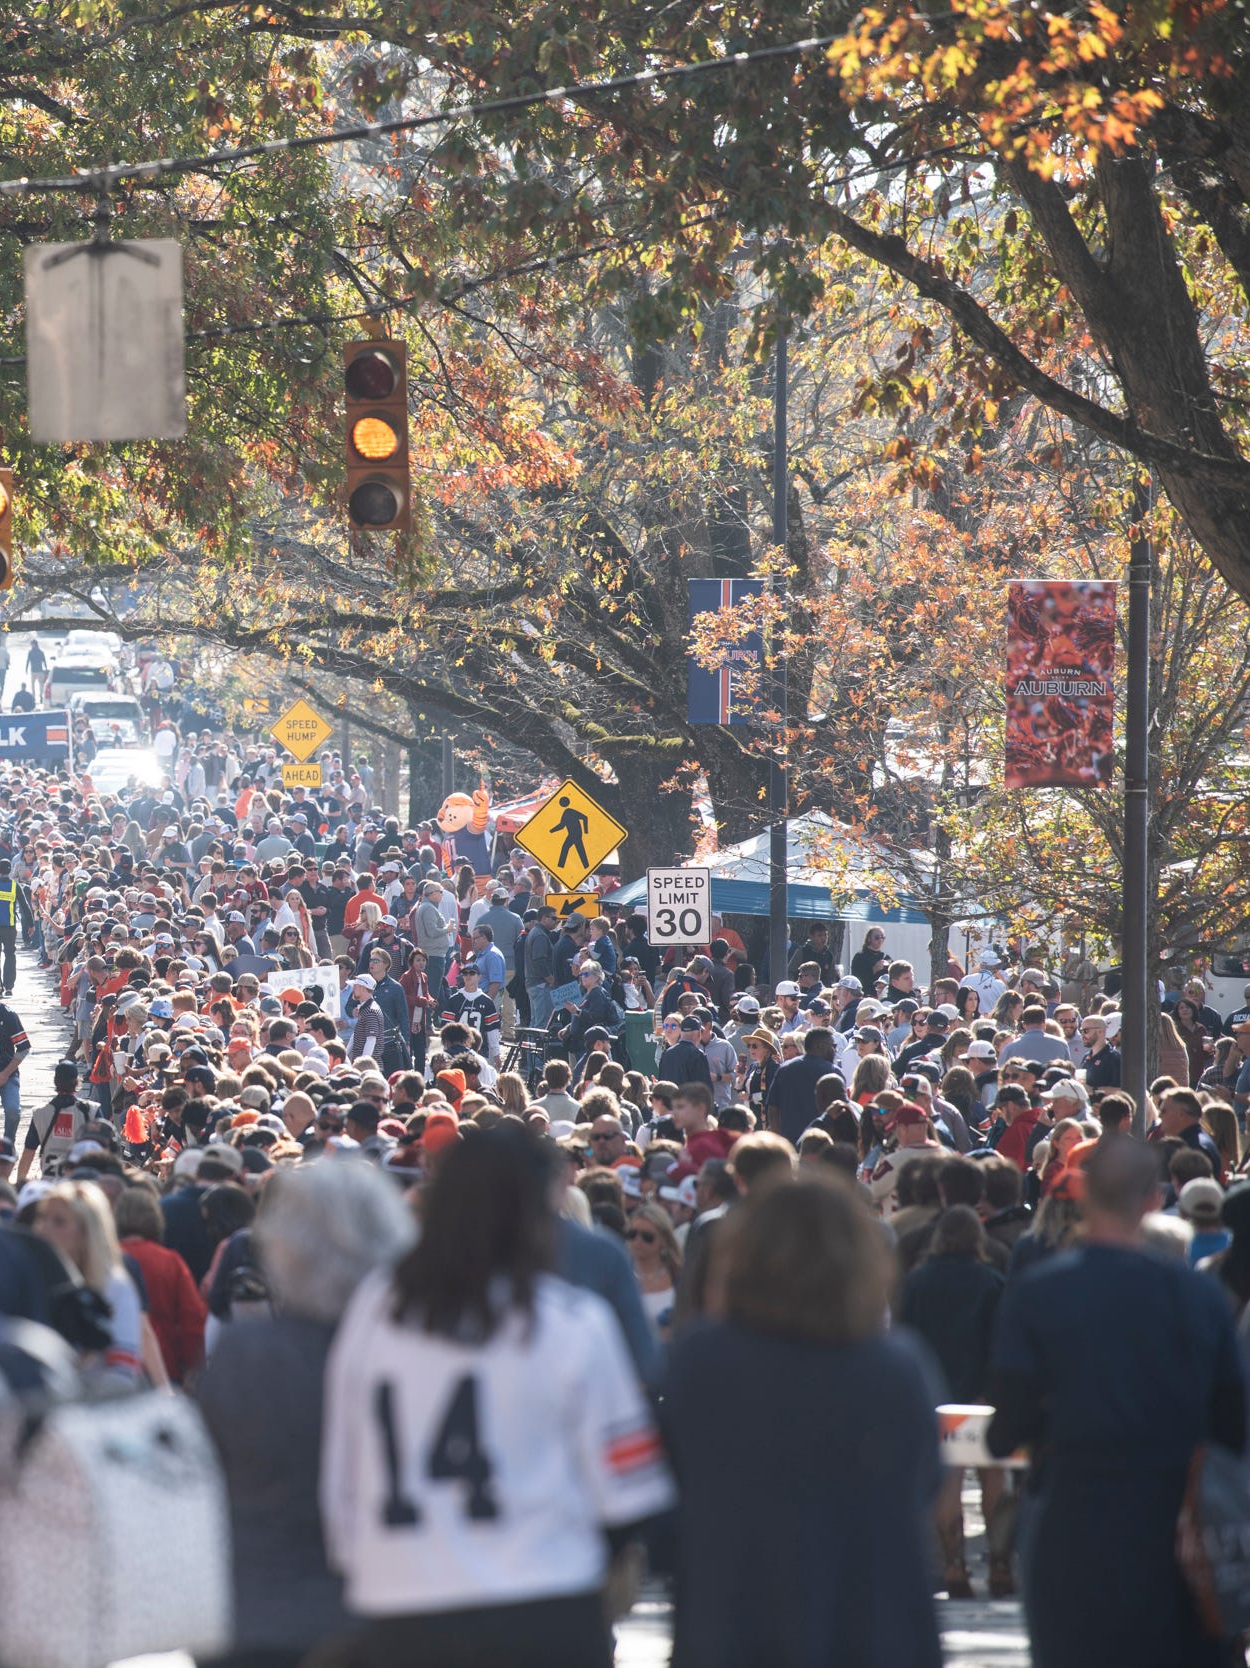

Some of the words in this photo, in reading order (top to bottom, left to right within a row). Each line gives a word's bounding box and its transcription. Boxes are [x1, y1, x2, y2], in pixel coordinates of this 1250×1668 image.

[1040, 668, 1081, 676] AUBURN
[1014, 681, 1107, 696] AUBURN
[286, 720, 318, 729] SPEED
[287, 733, 317, 741] HUMP
[285, 770, 319, 781] AHEAD
[653, 877, 705, 889] SPEED
[659, 892, 699, 905] LIMIT
[655, 908, 702, 937] 30
[373, 1371, 502, 1526] 14
